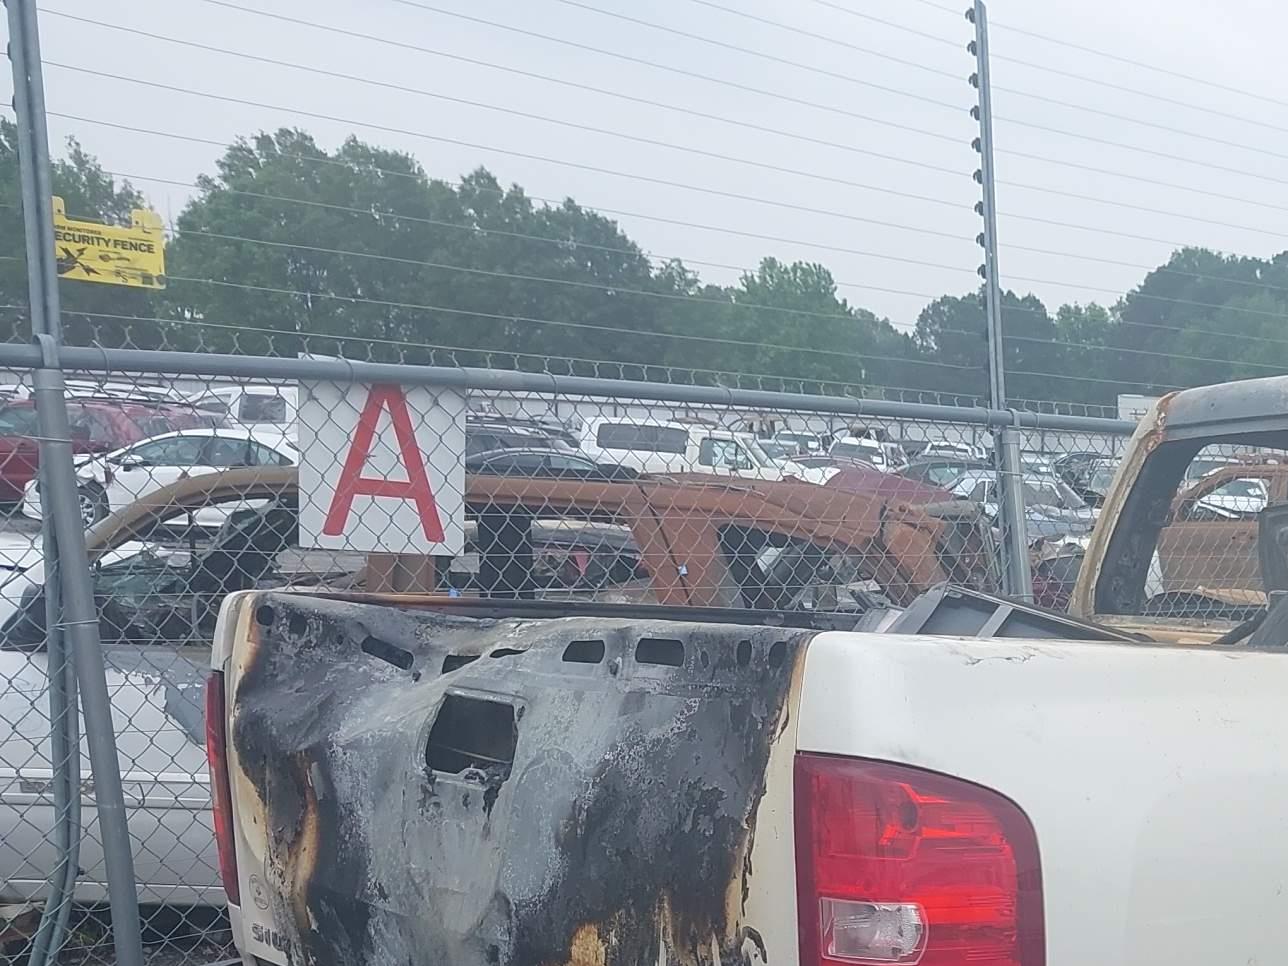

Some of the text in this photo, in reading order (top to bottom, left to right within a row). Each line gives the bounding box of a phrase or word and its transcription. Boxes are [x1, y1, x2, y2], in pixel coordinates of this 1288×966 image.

[55, 231, 155, 254] ECURITY FENCE
[322, 381, 445, 543] A
